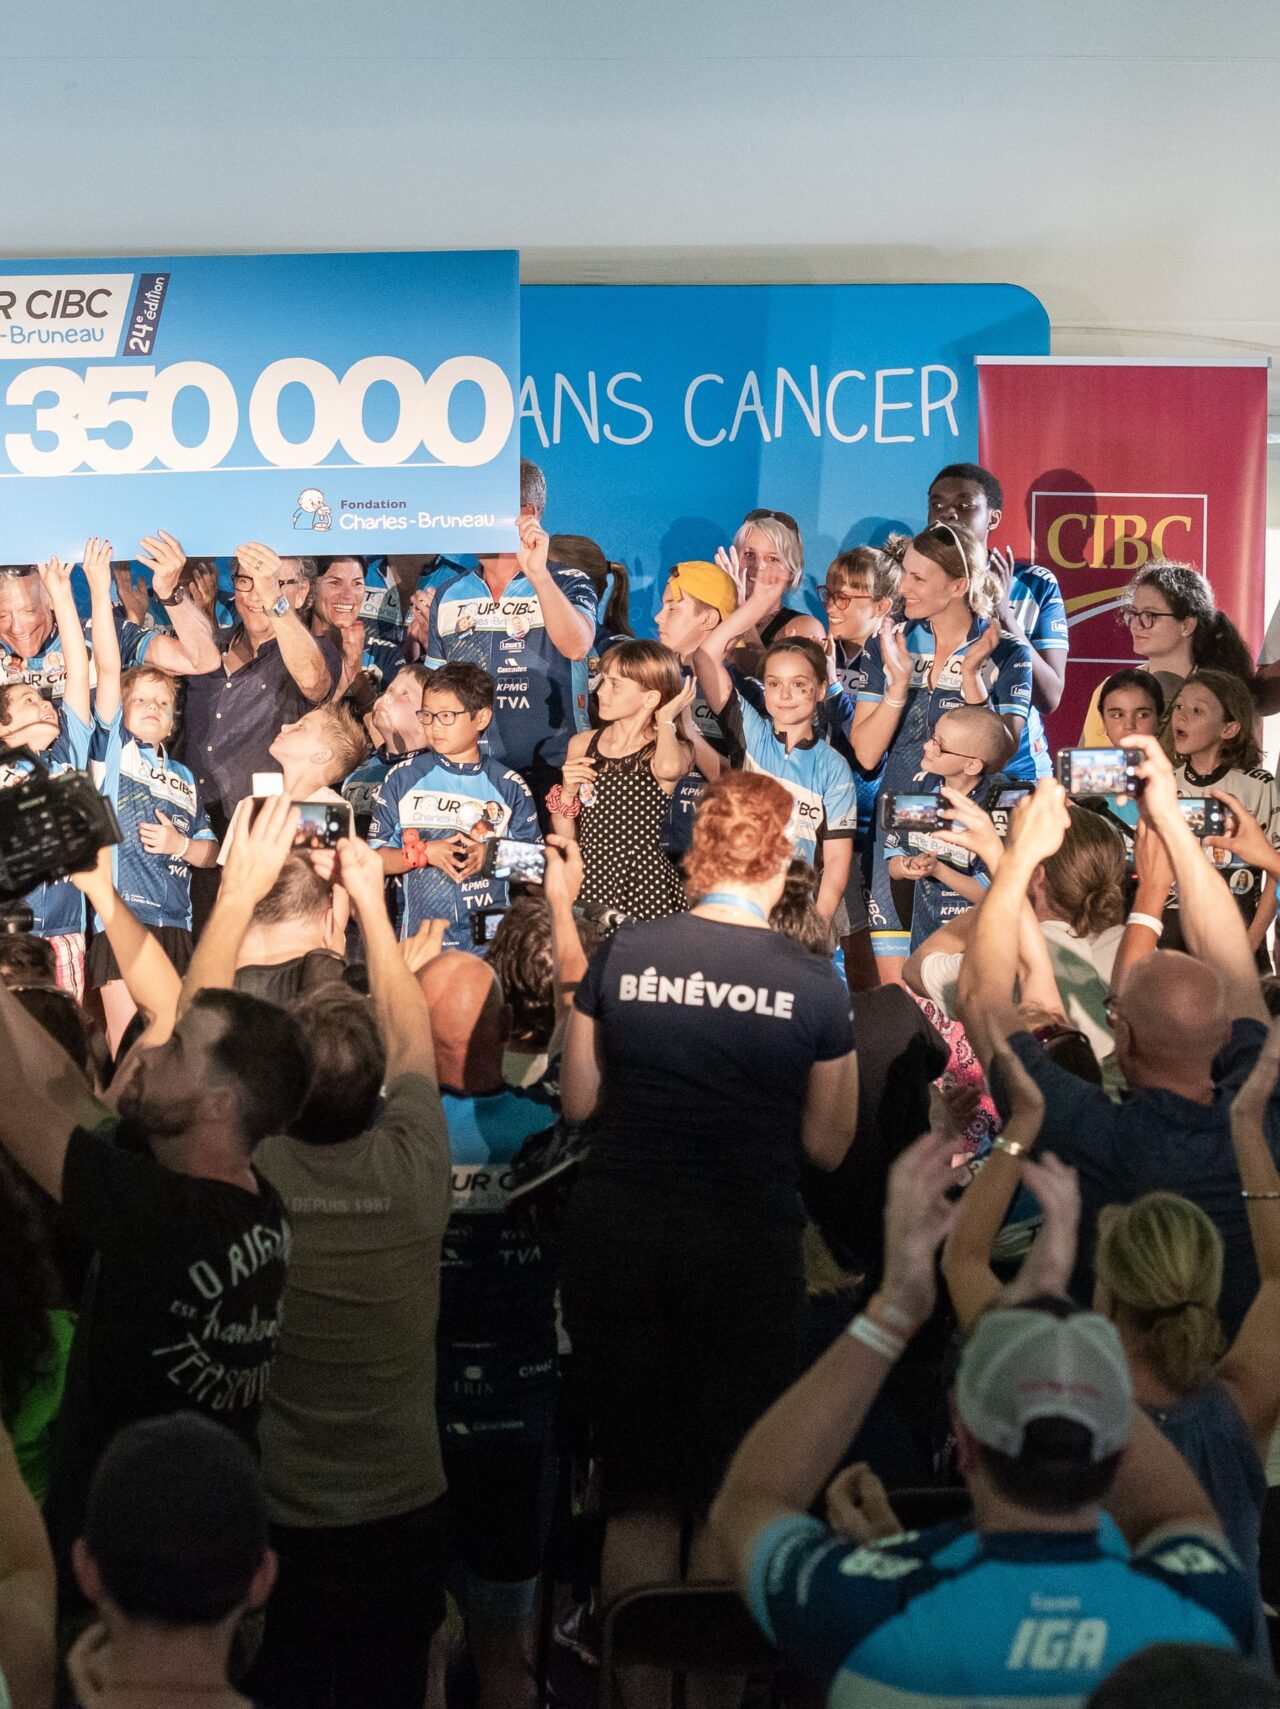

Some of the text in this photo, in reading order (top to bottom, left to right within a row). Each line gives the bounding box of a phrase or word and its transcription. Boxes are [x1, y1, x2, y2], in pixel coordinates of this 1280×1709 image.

[25, 288, 113, 320] CIBC
[144, 276, 165, 321] édition
[520, 370, 654, 448] ANS
[684, 364, 960, 448] CANCER
[5, 360, 238, 477] 350
[249, 355, 516, 467] 000
[340, 499, 407, 510] Fondation
[1047, 512, 1193, 570] CIBC
[496, 665, 528, 674] Cascades
[496, 682, 529, 692] KPMG
[496, 696, 530, 709] TVA
[680, 786, 704, 798] KPM
[413, 796, 462, 814] TOUR
[799, 801, 821, 820] BC
[460, 879, 490, 893] KPMG
[462, 893, 494, 910] TVA
[619, 965, 796, 1020] BÉNÉVOLE
[451, 1172, 490, 1192] UR
[1006, 1618, 1109, 1671] IGA
